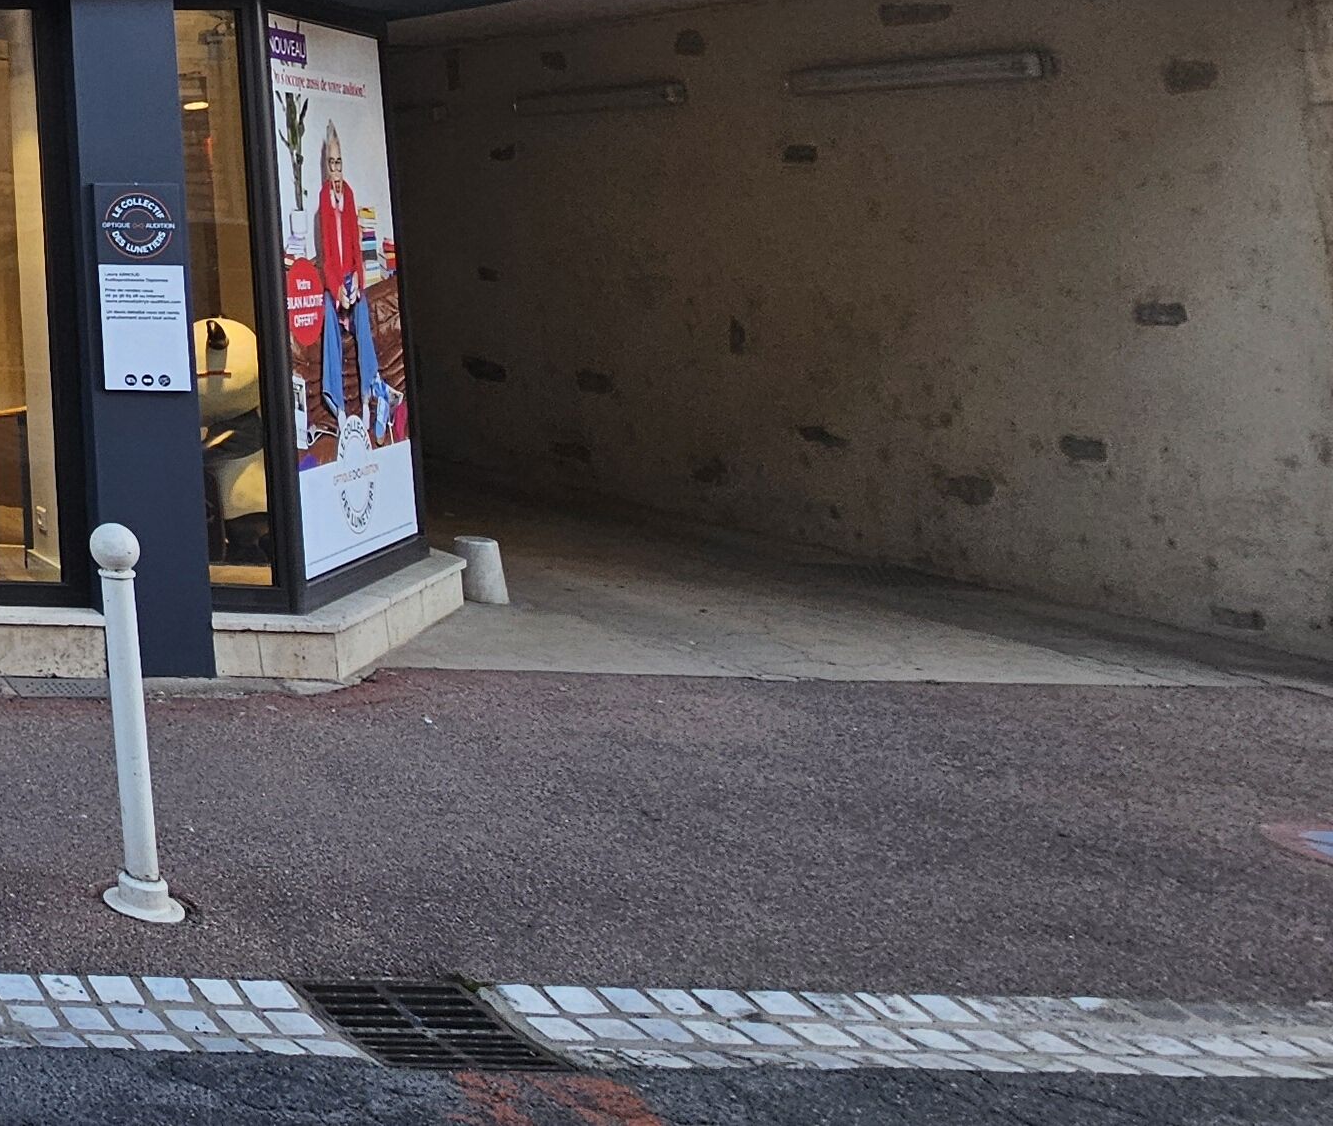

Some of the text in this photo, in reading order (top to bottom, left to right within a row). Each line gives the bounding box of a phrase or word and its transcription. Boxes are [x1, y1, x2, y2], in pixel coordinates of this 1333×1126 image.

[269, 36, 306, 59] NOUVEAU
[112, 198, 165, 219] LE COLLECTIF
[112, 230, 166, 253] DES LUNETIERS
